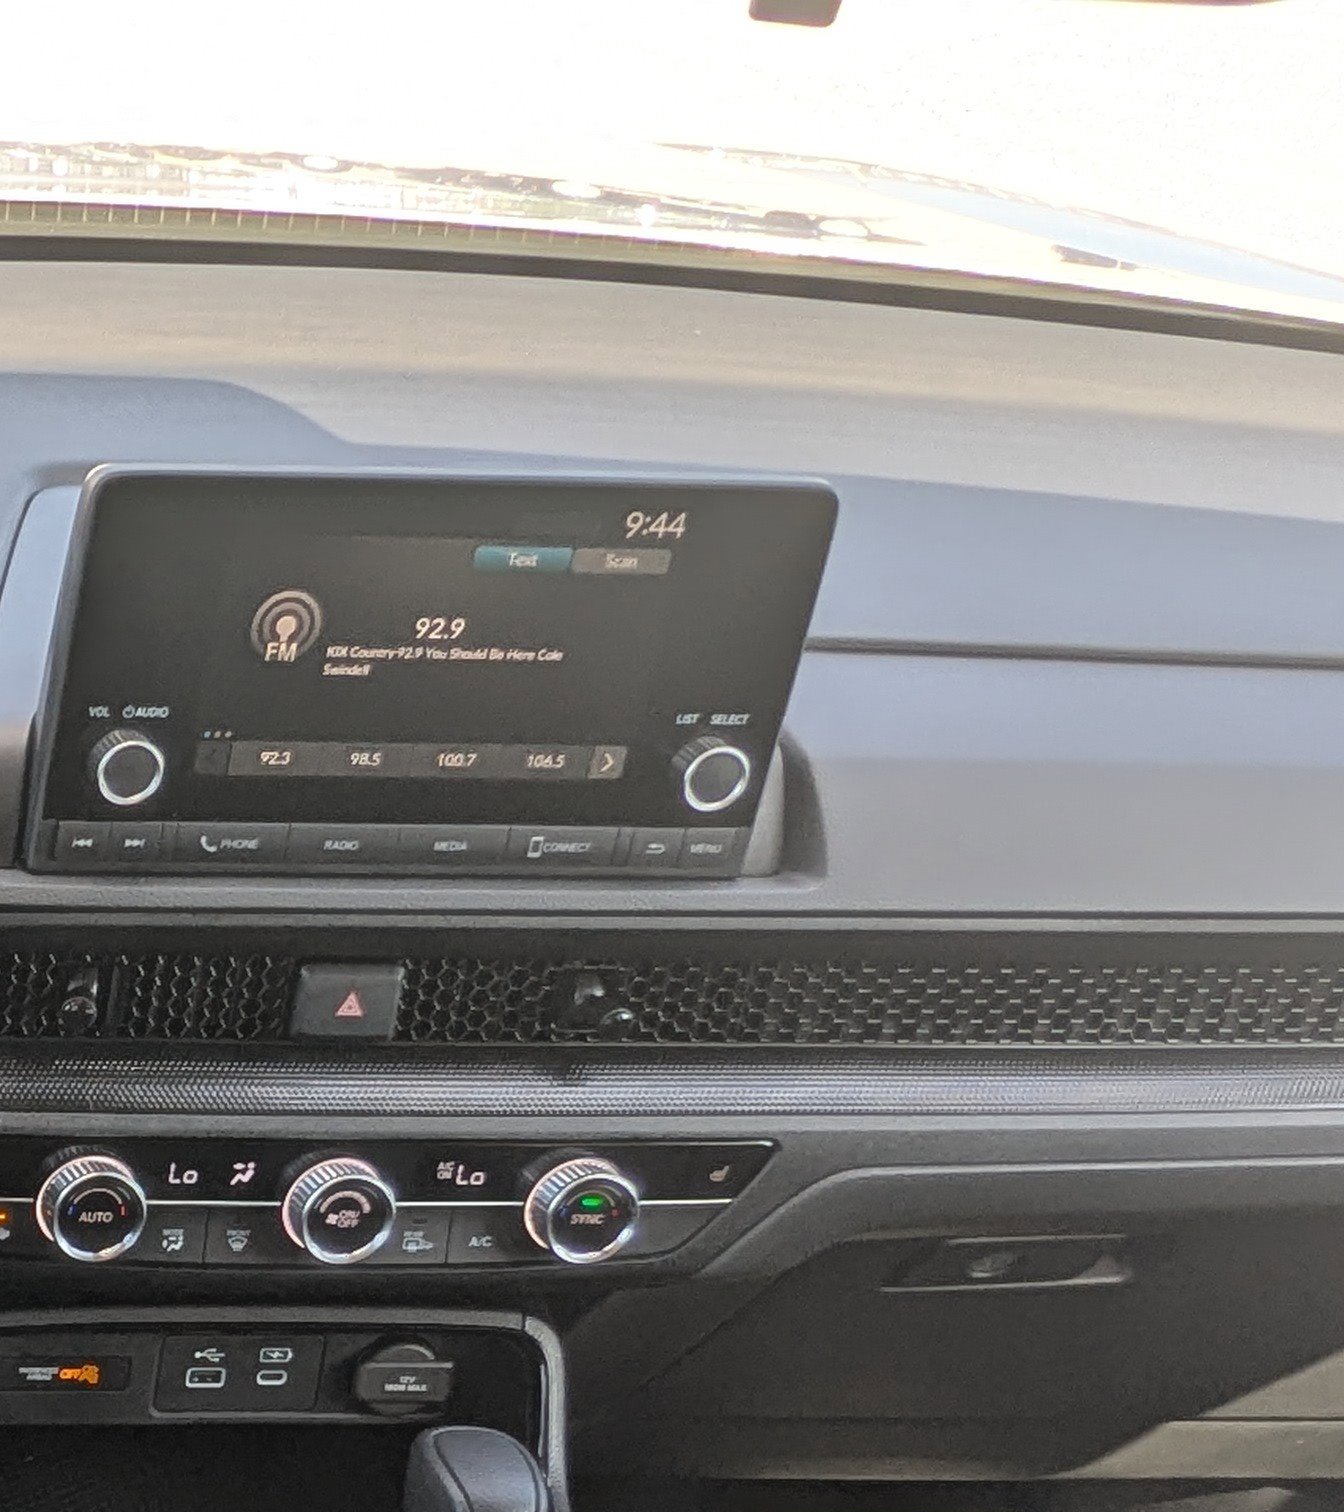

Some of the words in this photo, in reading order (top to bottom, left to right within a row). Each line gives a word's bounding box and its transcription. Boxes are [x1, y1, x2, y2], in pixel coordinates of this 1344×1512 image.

[625, 511, 688, 539] 9:44
[415, 618, 465, 640] 92.9
[265, 643, 297, 662] FM
[89, 706, 110, 718] VOL
[135, 706, 169, 718] AUDIO
[676, 713, 700, 725] LIST
[709, 714, 750, 725] SELECT
[260, 751, 292, 765] 92.3
[350, 752, 382, 766] 98.5
[436, 753, 477, 767] 100.7
[220, 838, 259, 850] PHONE
[323, 840, 359, 850] RADIO
[78, 1211, 113, 1224] AUTO
[570, 1213, 605, 1226] SYNC
[468, 1235, 492, 1249] A/C
